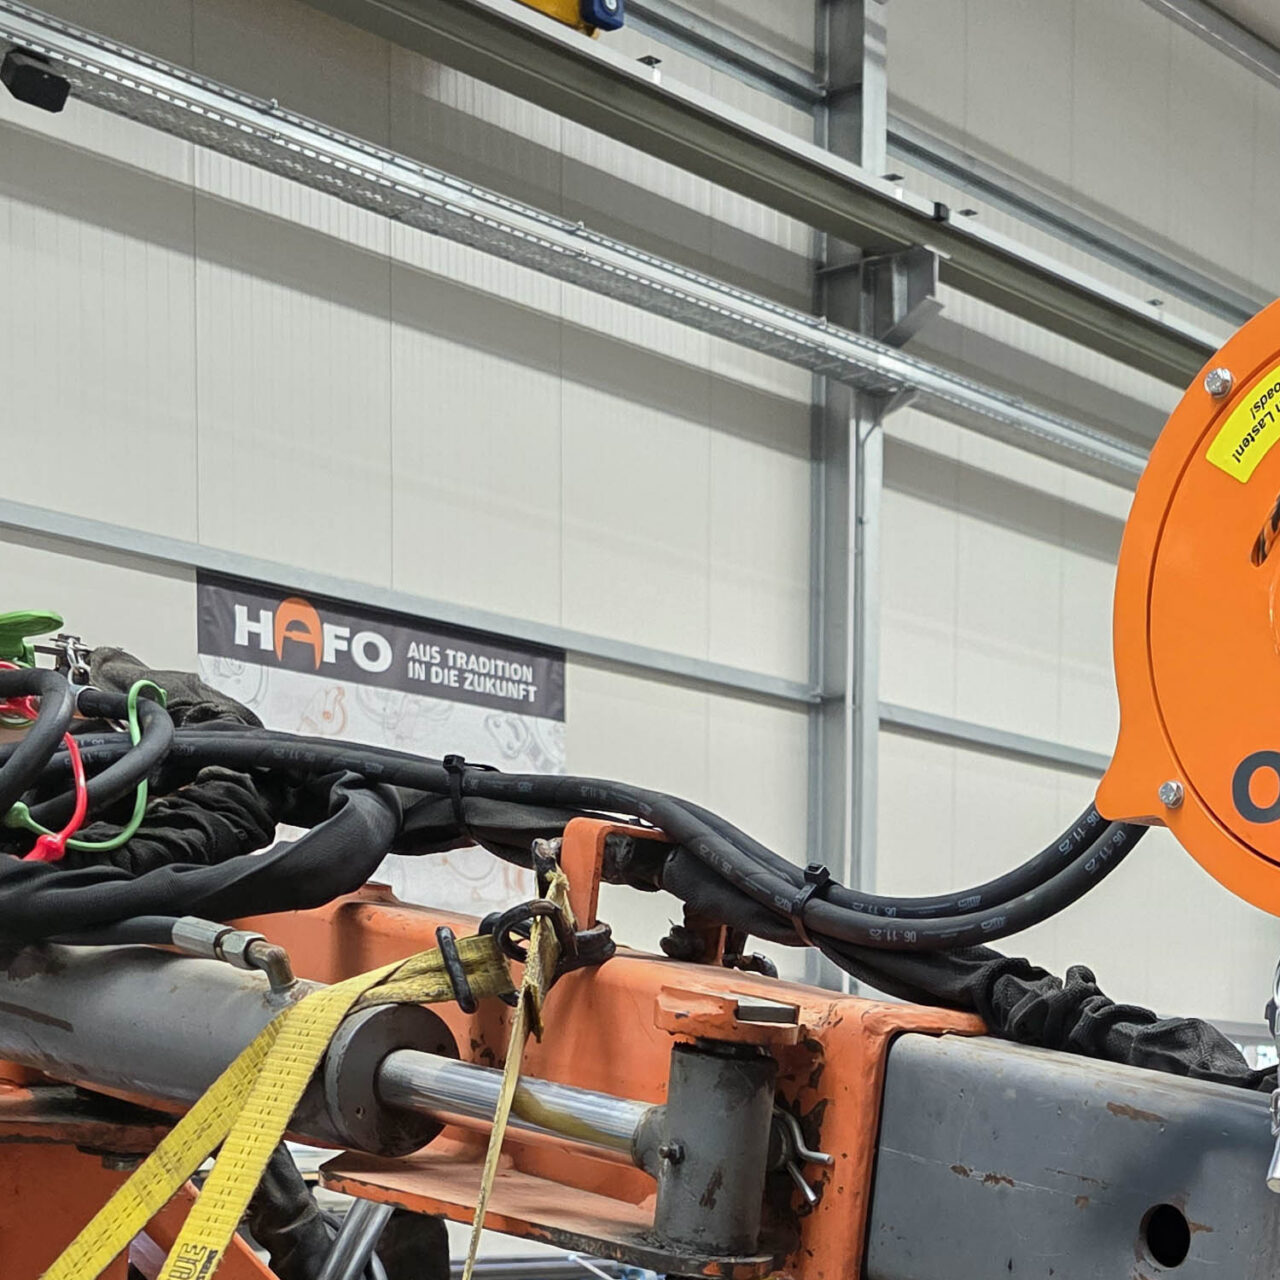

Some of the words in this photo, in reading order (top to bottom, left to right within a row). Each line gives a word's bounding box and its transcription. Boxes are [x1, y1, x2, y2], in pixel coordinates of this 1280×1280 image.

[1232, 410, 1276, 464] Lasten!
[233, 596, 394, 673] HAFO
[406, 641, 441, 665] AUS
[445, 647, 535, 684] TRADITION
[407, 660, 426, 682] IN
[430, 665, 460, 689] DIE
[463, 672, 538, 703] ZUKUNFT
